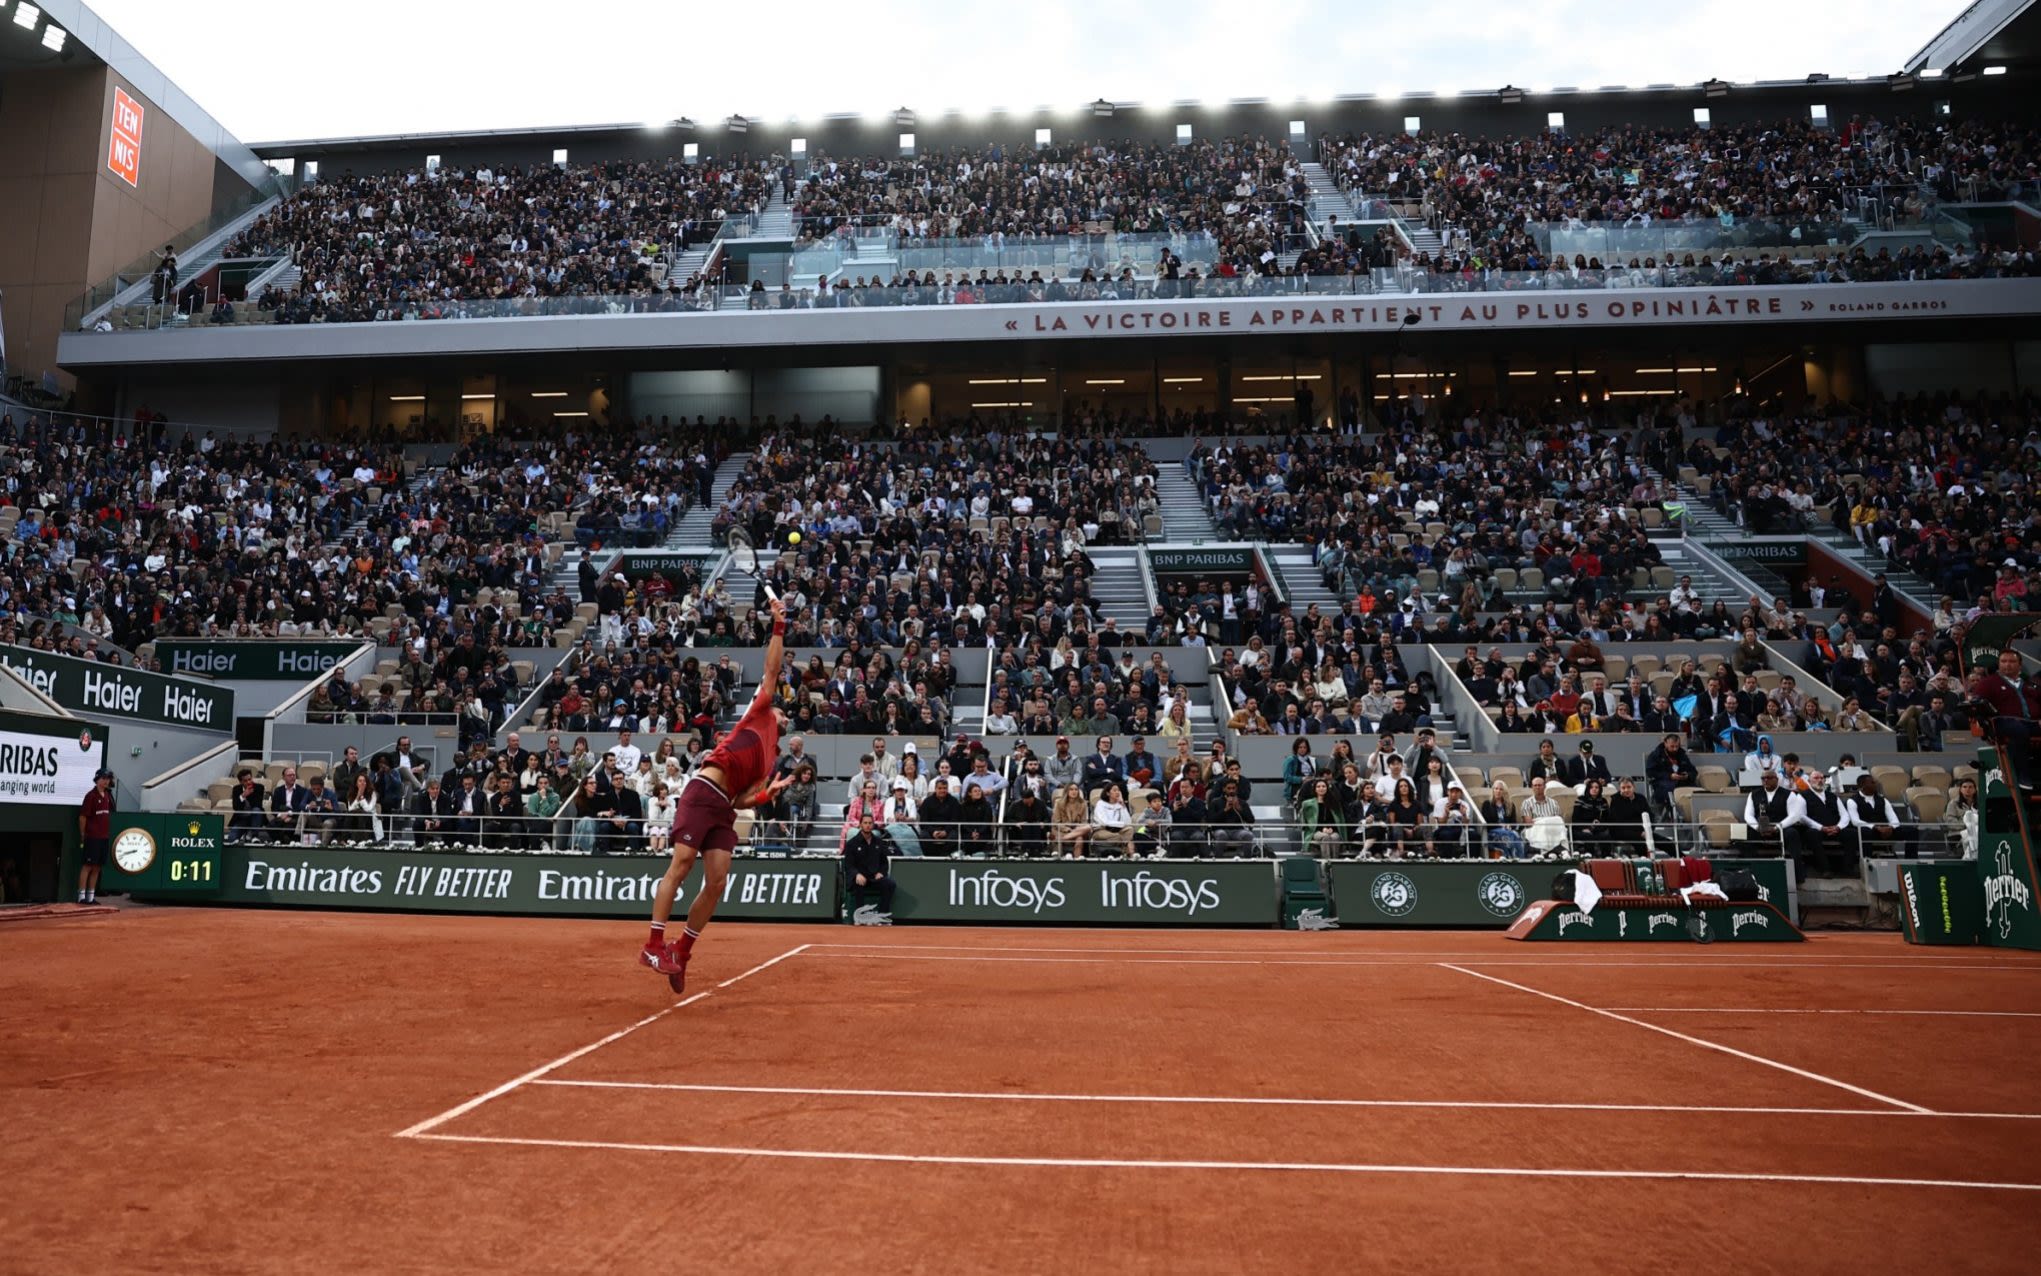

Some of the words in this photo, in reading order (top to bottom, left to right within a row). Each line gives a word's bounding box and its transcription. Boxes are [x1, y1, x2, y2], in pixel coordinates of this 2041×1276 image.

[118, 101, 138, 136] TEN
[115, 139, 134, 171] NIS
[1035, 314, 1067, 331] LA
[1084, 311, 1231, 330] VICTOIRE
[1249, 306, 1443, 326] APPARTIENT
[1460, 303, 1498, 321] AU
[1517, 302, 1590, 319] PLUS
[1607, 296, 1782, 318] OPINIÂTRE
[1829, 302, 1885, 312] ROLAND
[1891, 300, 1948, 311] GARROS
[632, 559, 658, 569] BNP
[661, 559, 706, 569] PARIBA
[1155, 554, 1183, 565] BNP
[1186, 553, 1244, 565] PARIBAS
[1736, 546, 1798, 557] PARIBAS
[173, 649, 236, 671] Haier
[2, 656, 57, 701] aier
[84, 670, 142, 713] Haier
[164, 685, 213, 723] Haier
[32, 780, 55, 793] world
[171, 837, 215, 848] ROLEX
[171, 861, 211, 881] 0:11
[245, 861, 383, 894] Emirates
[394, 866, 433, 896] FLY
[434, 868, 512, 898] BETTER
[740, 873, 822, 904] BETTER
[950, 869, 1065, 914] Infosys
[1101, 870, 1220, 915] Infosys
[1904, 871, 1920, 929] Wilson
